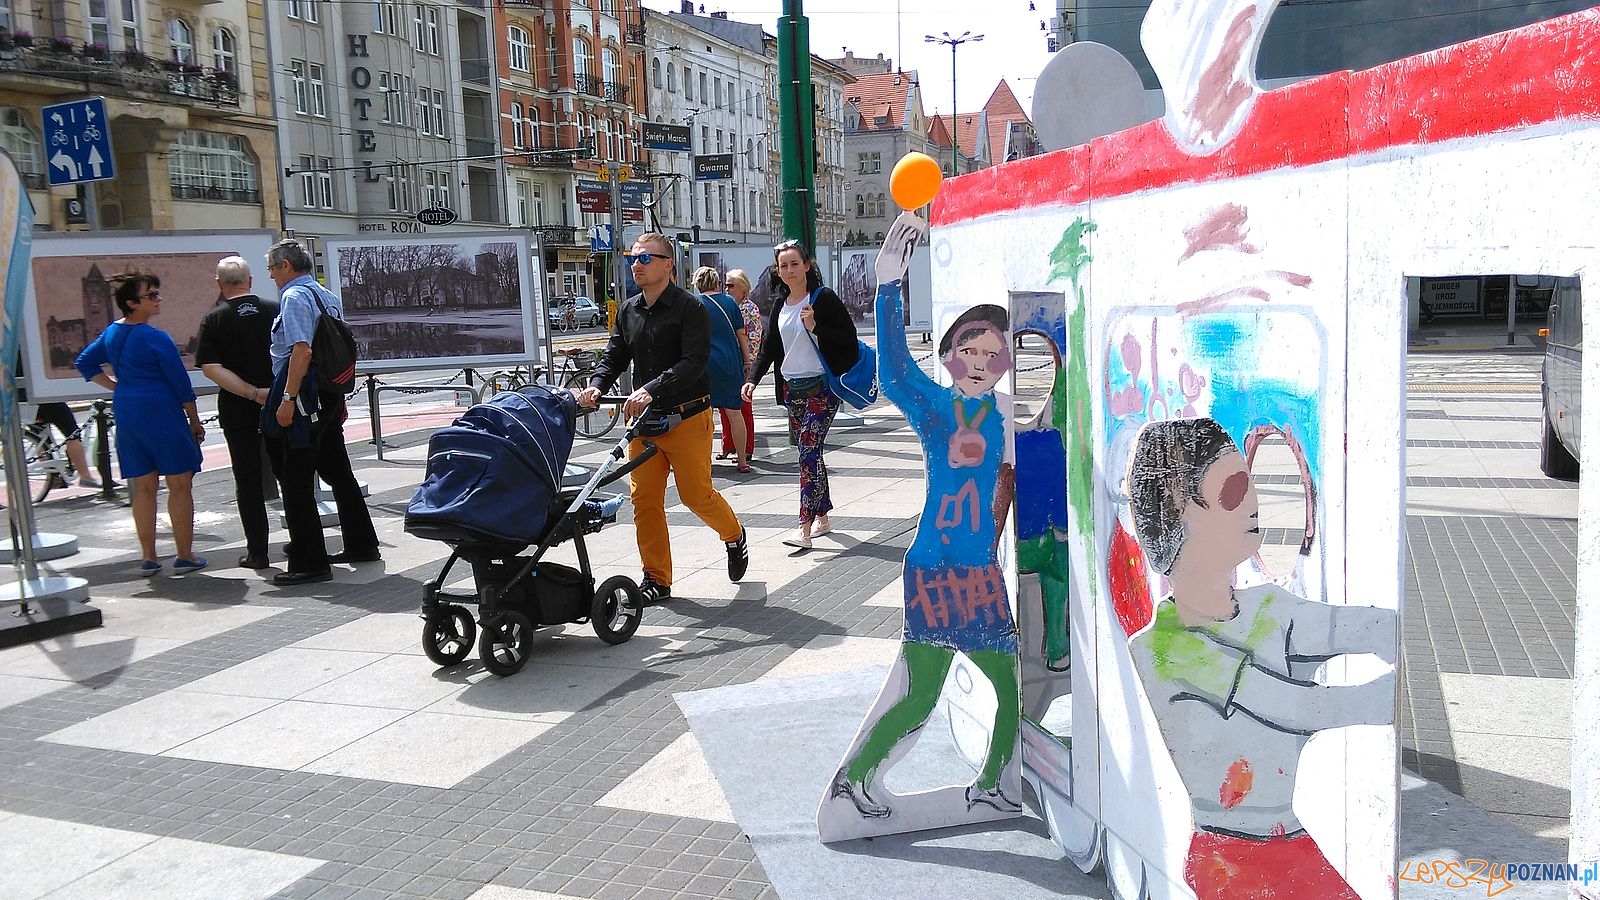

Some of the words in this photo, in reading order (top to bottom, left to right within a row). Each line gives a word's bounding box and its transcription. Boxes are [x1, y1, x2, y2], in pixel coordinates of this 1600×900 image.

[347, 34, 380, 183] HOTEL
[645, 129, 665, 143] Święty
[667, 133, 687, 143] Marcin
[700, 163, 729, 172] Gwarna
[421, 212, 451, 221] HOTEL
[358, 223, 387, 231] HOTEL
[1431, 282, 1460, 290] BURGER
[1435, 292, 1457, 300] GROZI
